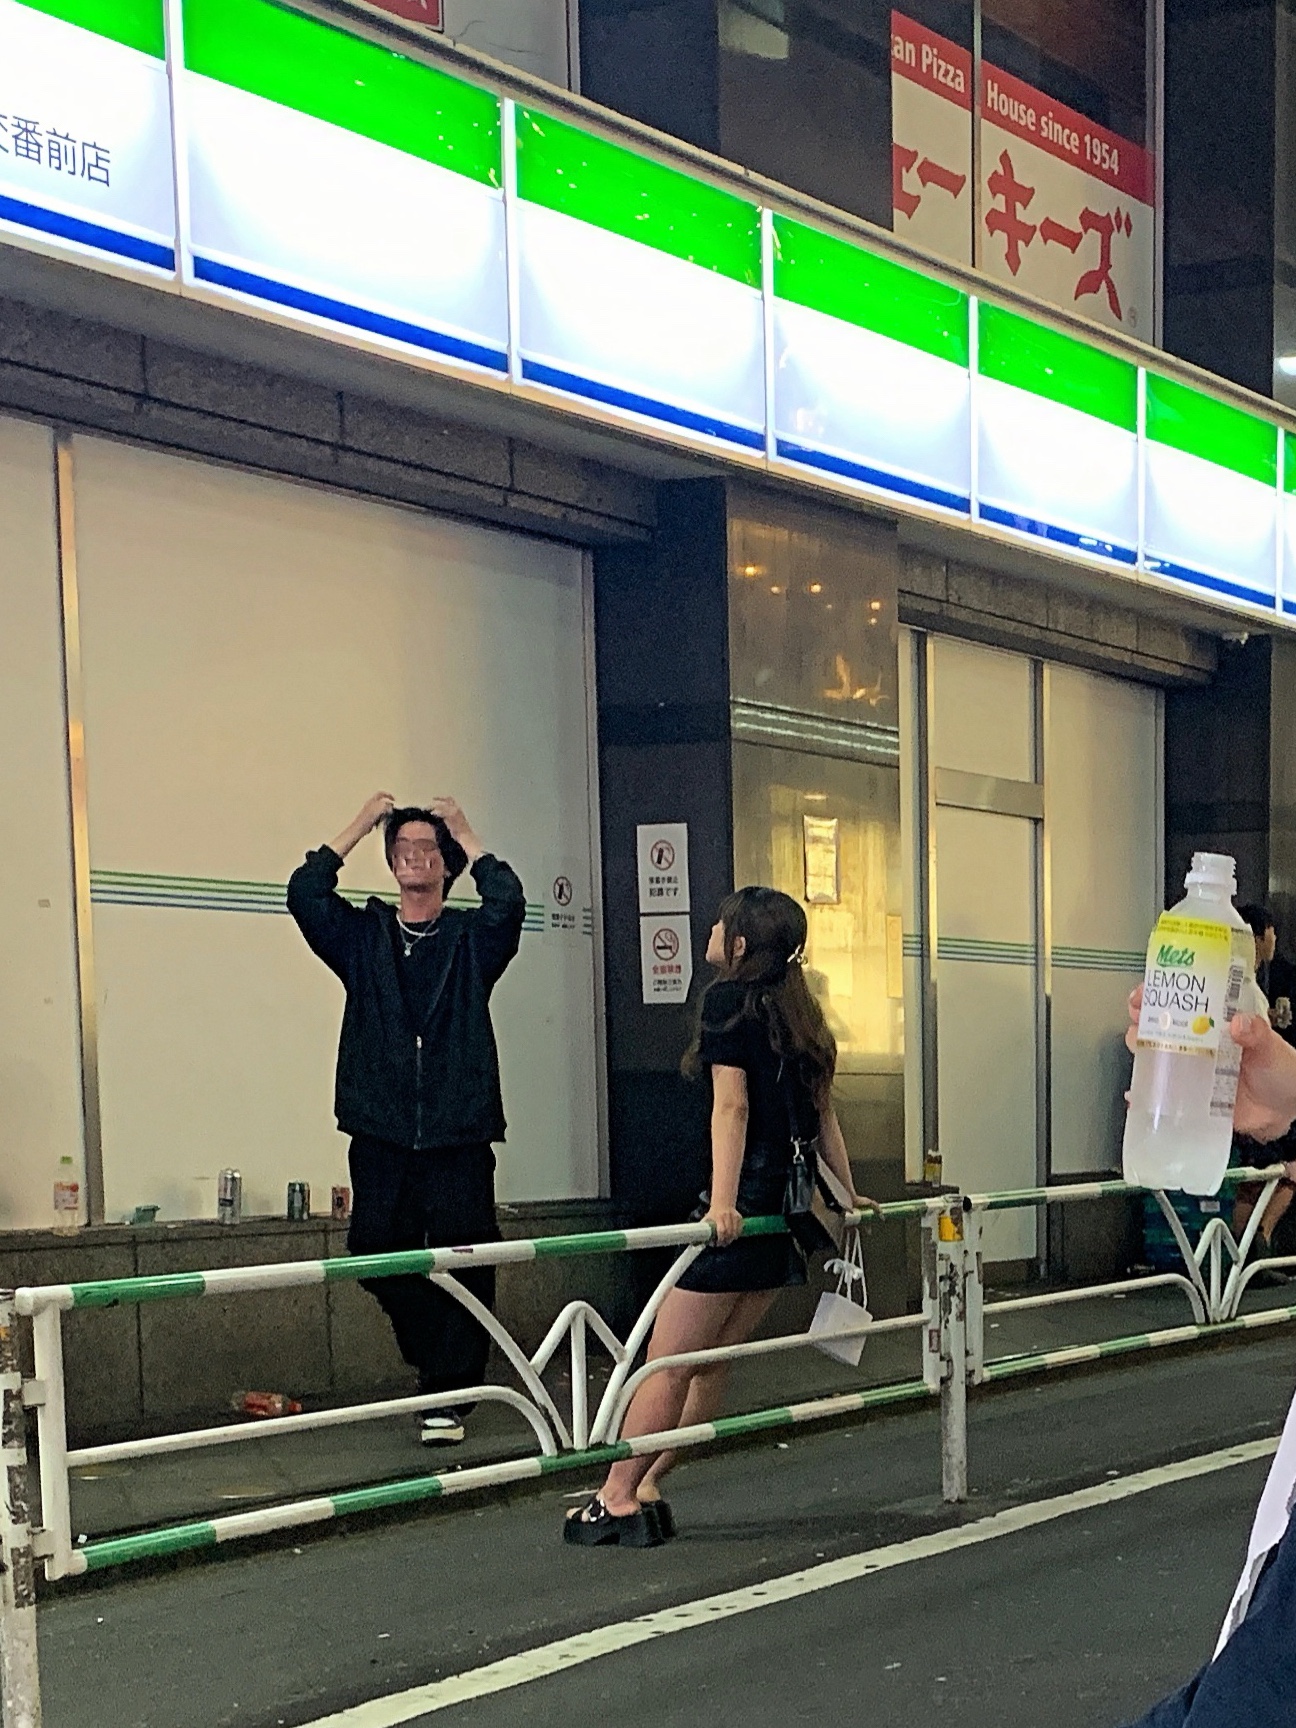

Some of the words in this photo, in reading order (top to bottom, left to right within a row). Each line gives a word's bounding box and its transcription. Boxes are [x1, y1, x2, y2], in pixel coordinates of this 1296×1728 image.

[922, 44, 965, 93] Pizza
[987, 79, 1036, 131] House
[1041, 111, 1079, 154] since
[1084, 126, 1120, 176] 1954
[1157, 944, 1195, 967] Mets
[1147, 969, 1206, 994] LEMON
[1144, 987, 1209, 1013] SQUASH
